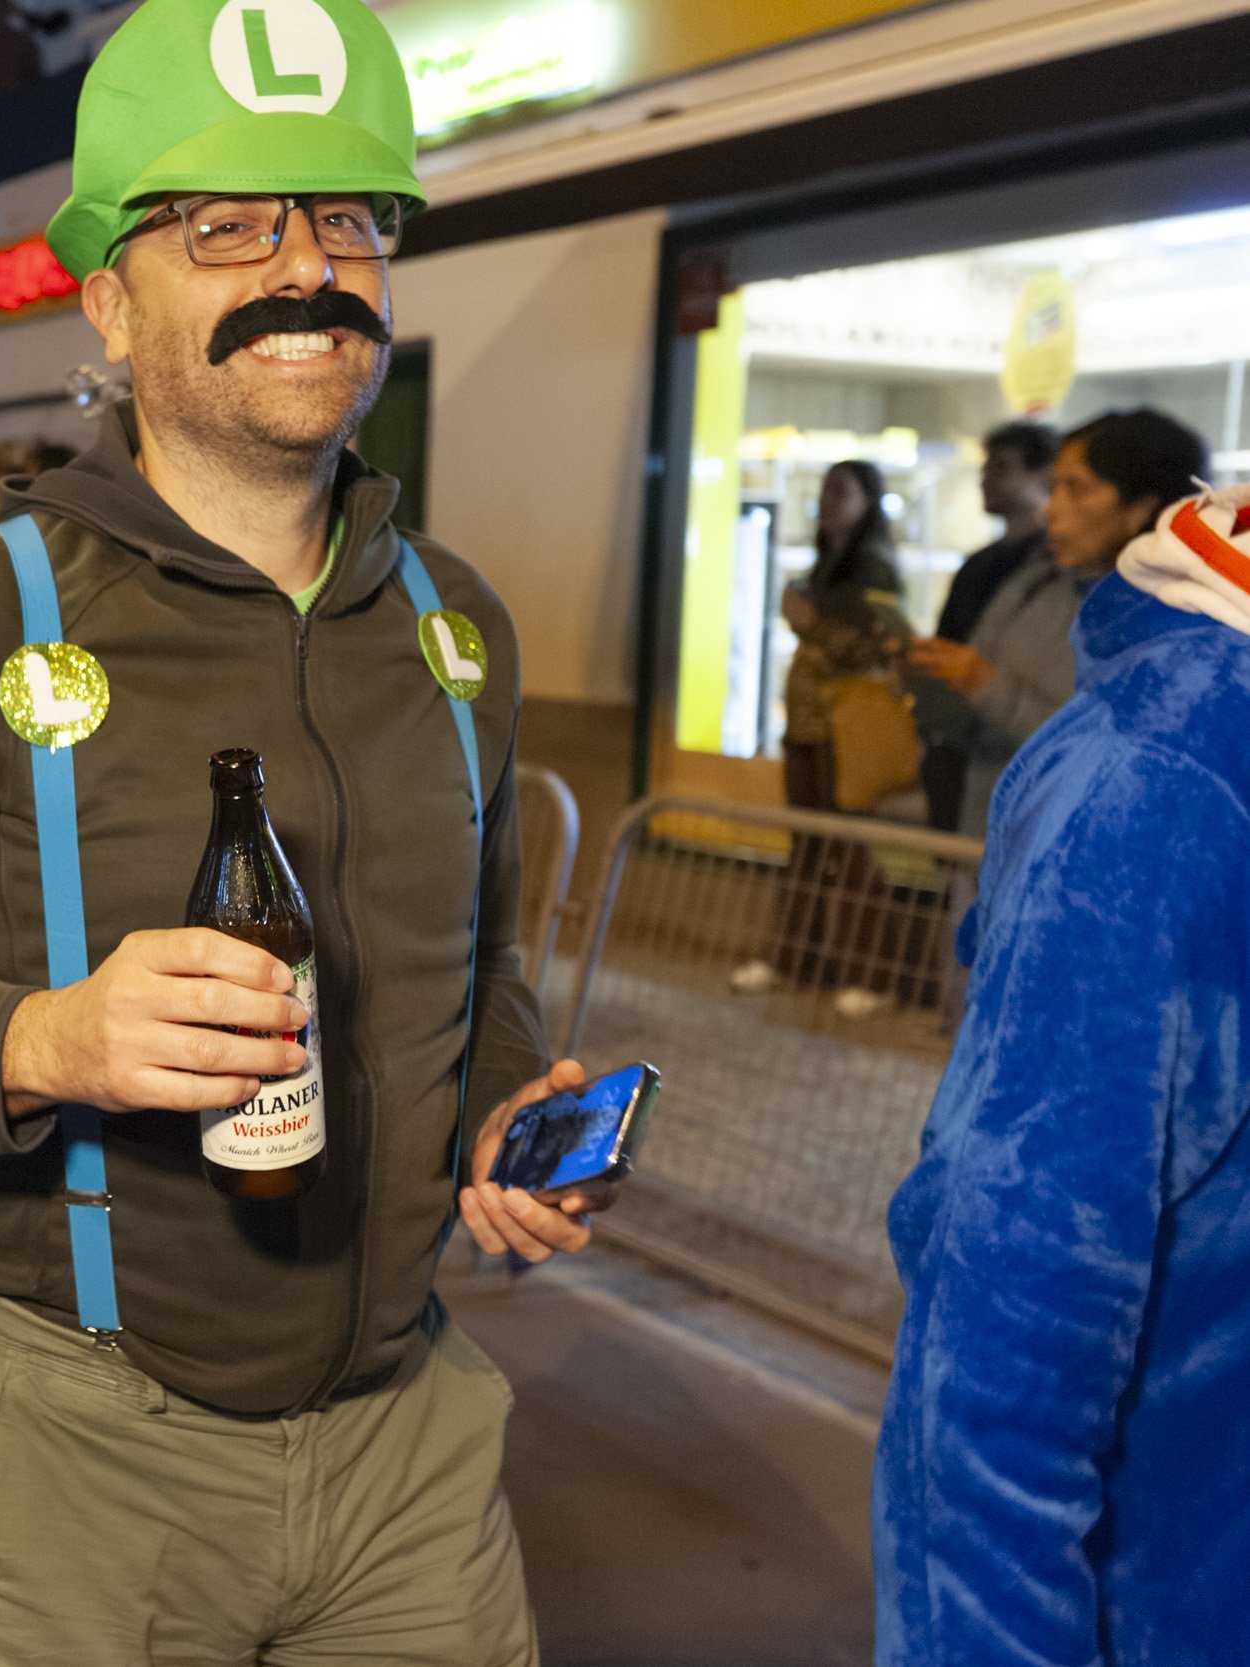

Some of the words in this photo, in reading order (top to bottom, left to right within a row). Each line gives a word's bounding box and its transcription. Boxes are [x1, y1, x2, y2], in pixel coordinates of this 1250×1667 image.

[241, 9, 323, 97] L
[431, 615, 483, 682] L
[24, 651, 92, 725] L
[217, 1080, 320, 1116] ULANER
[220, 1144, 261, 1157] Munich
[265, 1141, 299, 1156] Wheat
[232, 1113, 311, 1138] Weissbier
